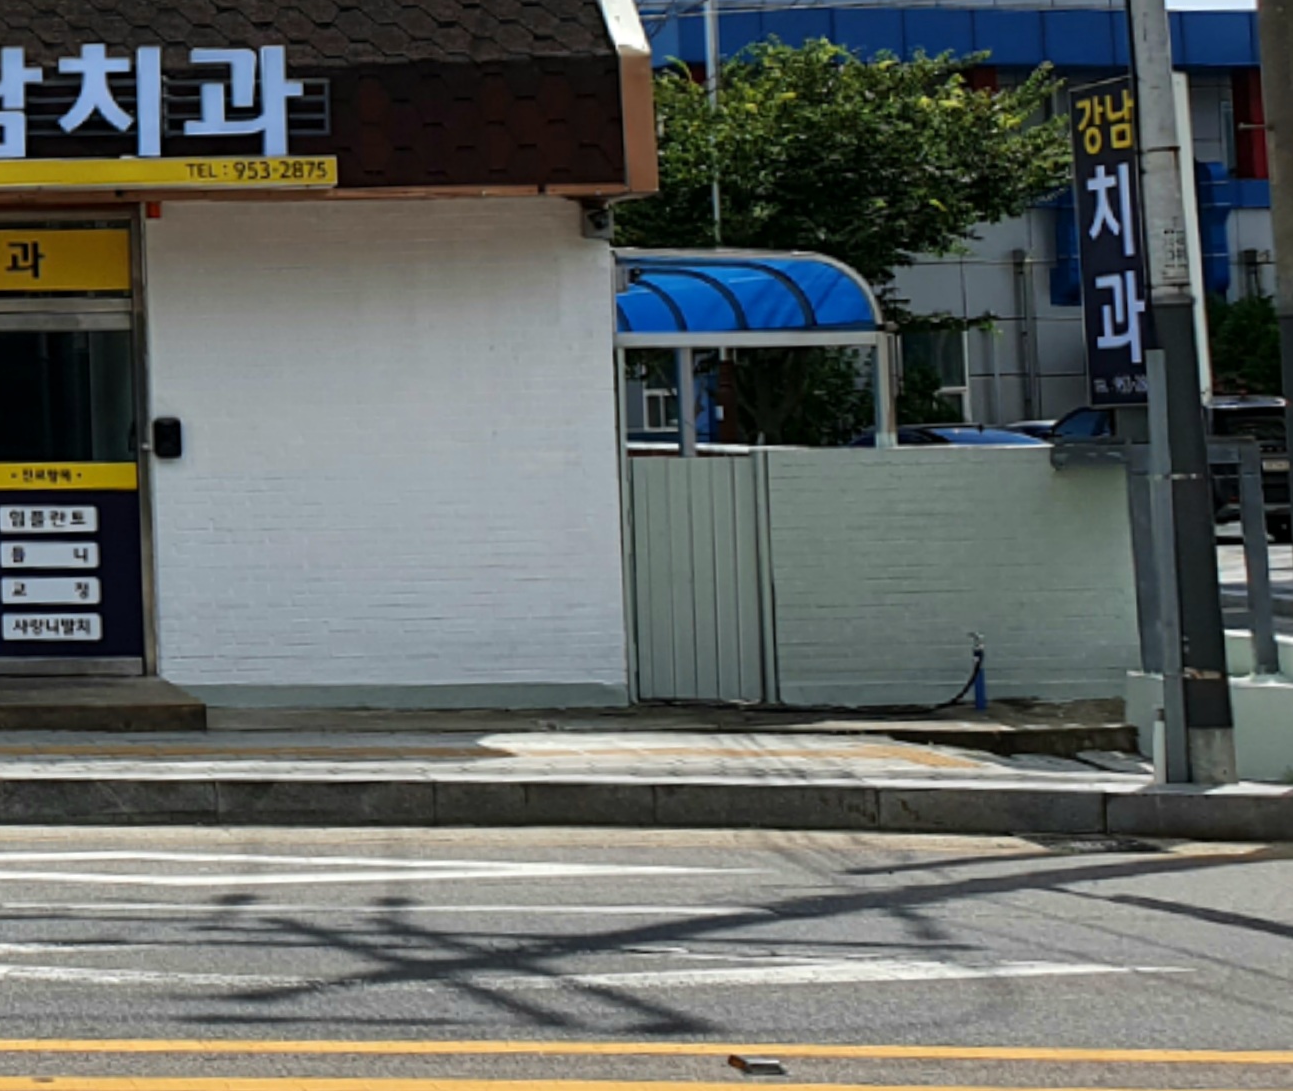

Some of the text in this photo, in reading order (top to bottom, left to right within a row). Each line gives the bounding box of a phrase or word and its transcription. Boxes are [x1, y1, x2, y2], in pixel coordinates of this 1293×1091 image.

[1075, 89, 1134, 155] 강남
[232, 160, 328, 179] 953-2875
[1086, 161, 1145, 364] 치과
[9, 509, 87, 528] 임플란트
[13, 618, 91, 636] 사랑니발치
